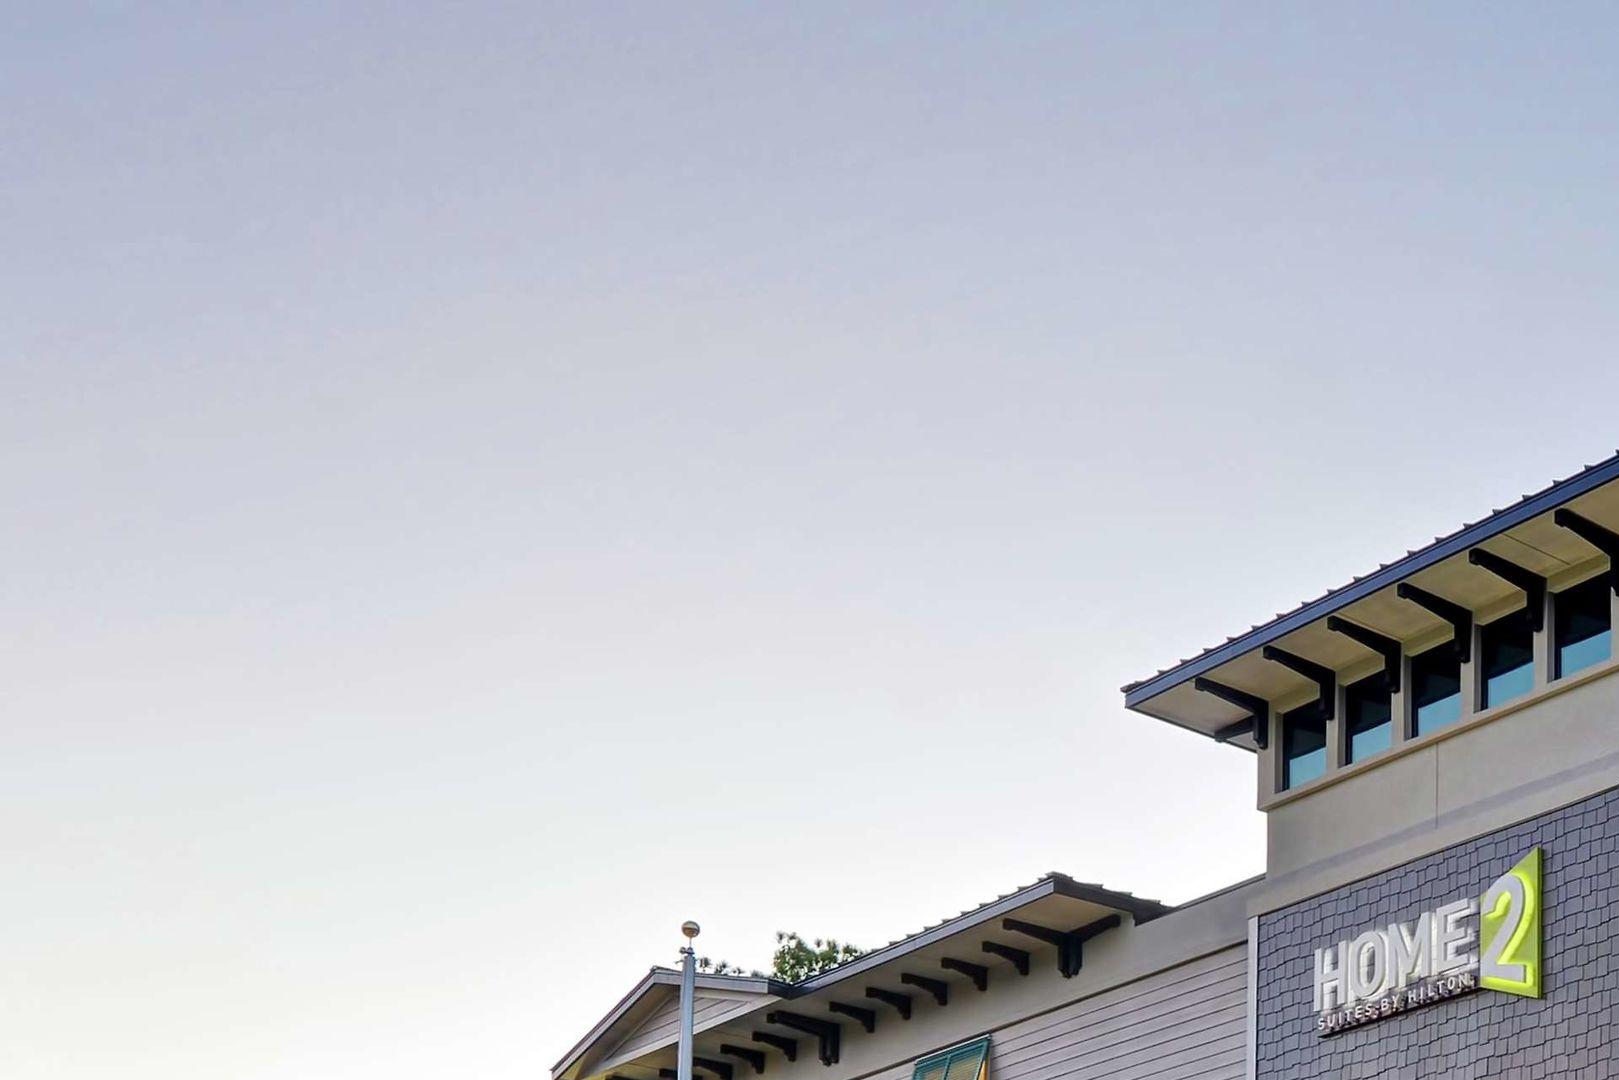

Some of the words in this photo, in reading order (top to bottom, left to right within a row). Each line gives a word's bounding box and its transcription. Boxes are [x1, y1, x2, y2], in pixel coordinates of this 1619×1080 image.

[1313, 897, 1473, 1012] HOME
[1318, 1003, 1373, 1031] SUITES
[1380, 994, 1400, 1011] BY
[1408, 972, 1473, 1003] HILTON
